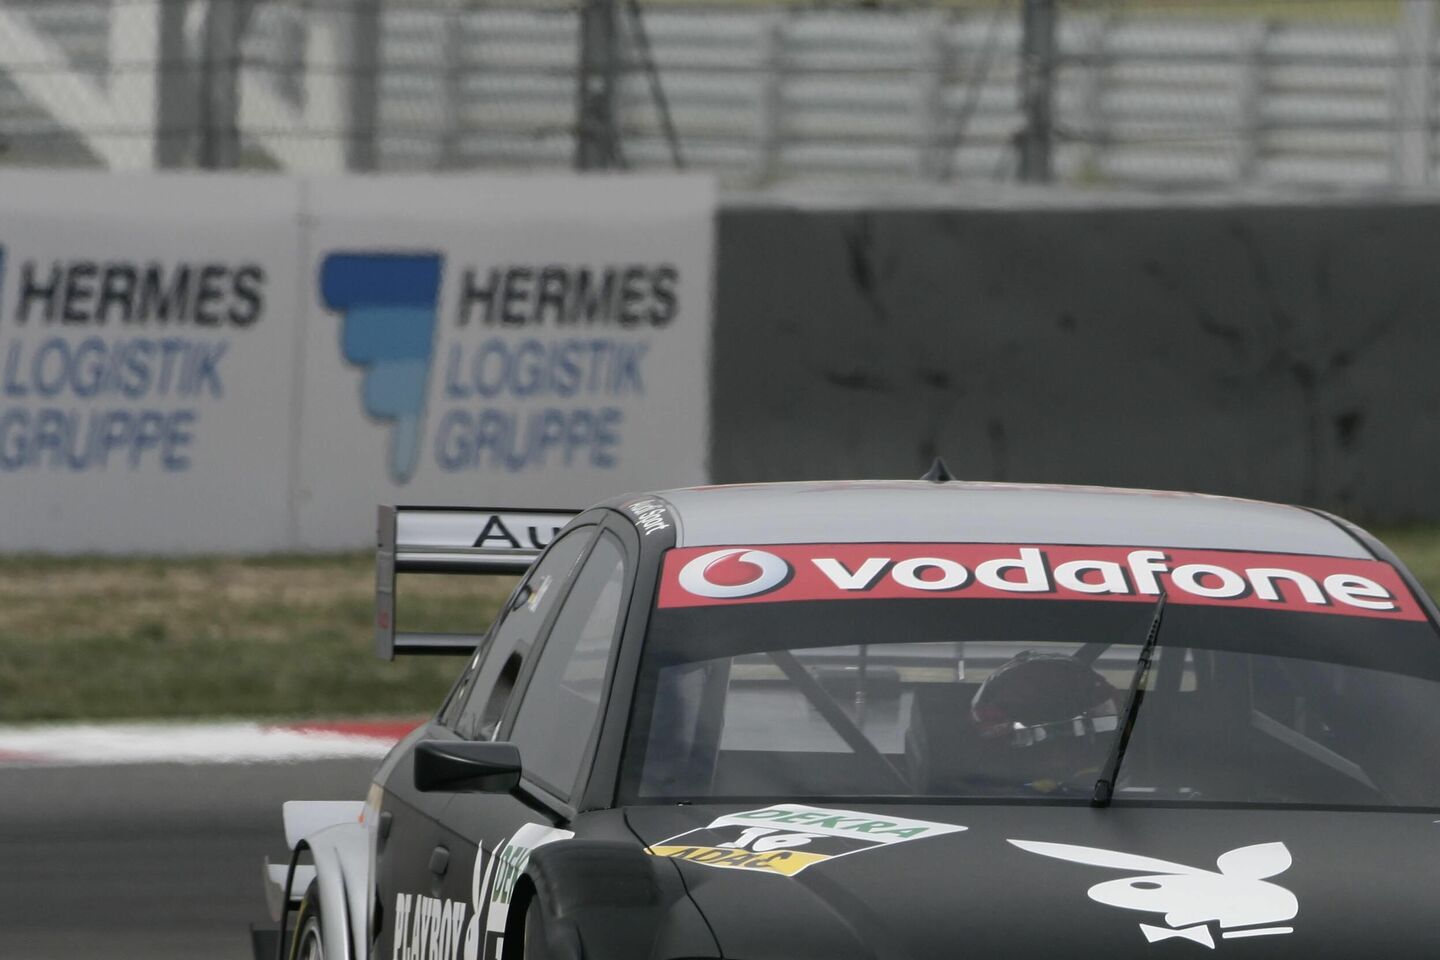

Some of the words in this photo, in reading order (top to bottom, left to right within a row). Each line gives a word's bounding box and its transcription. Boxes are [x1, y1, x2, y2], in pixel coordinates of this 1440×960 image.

[16, 260, 267, 327] HERMES
[457, 263, 680, 328] HERMES
[4, 336, 229, 398] LOGISTIK
[445, 338, 652, 399] LOGISTIK
[0, 407, 197, 471] GRUPPE
[435, 407, 623, 472] GRUPPE
[635, 508, 670, 536] Sport
[811, 547, 1399, 611] vodafone
[716, 827, 831, 851] 16
[733, 809, 929, 838] DEKRA
[666, 847, 793, 867] ADAC
